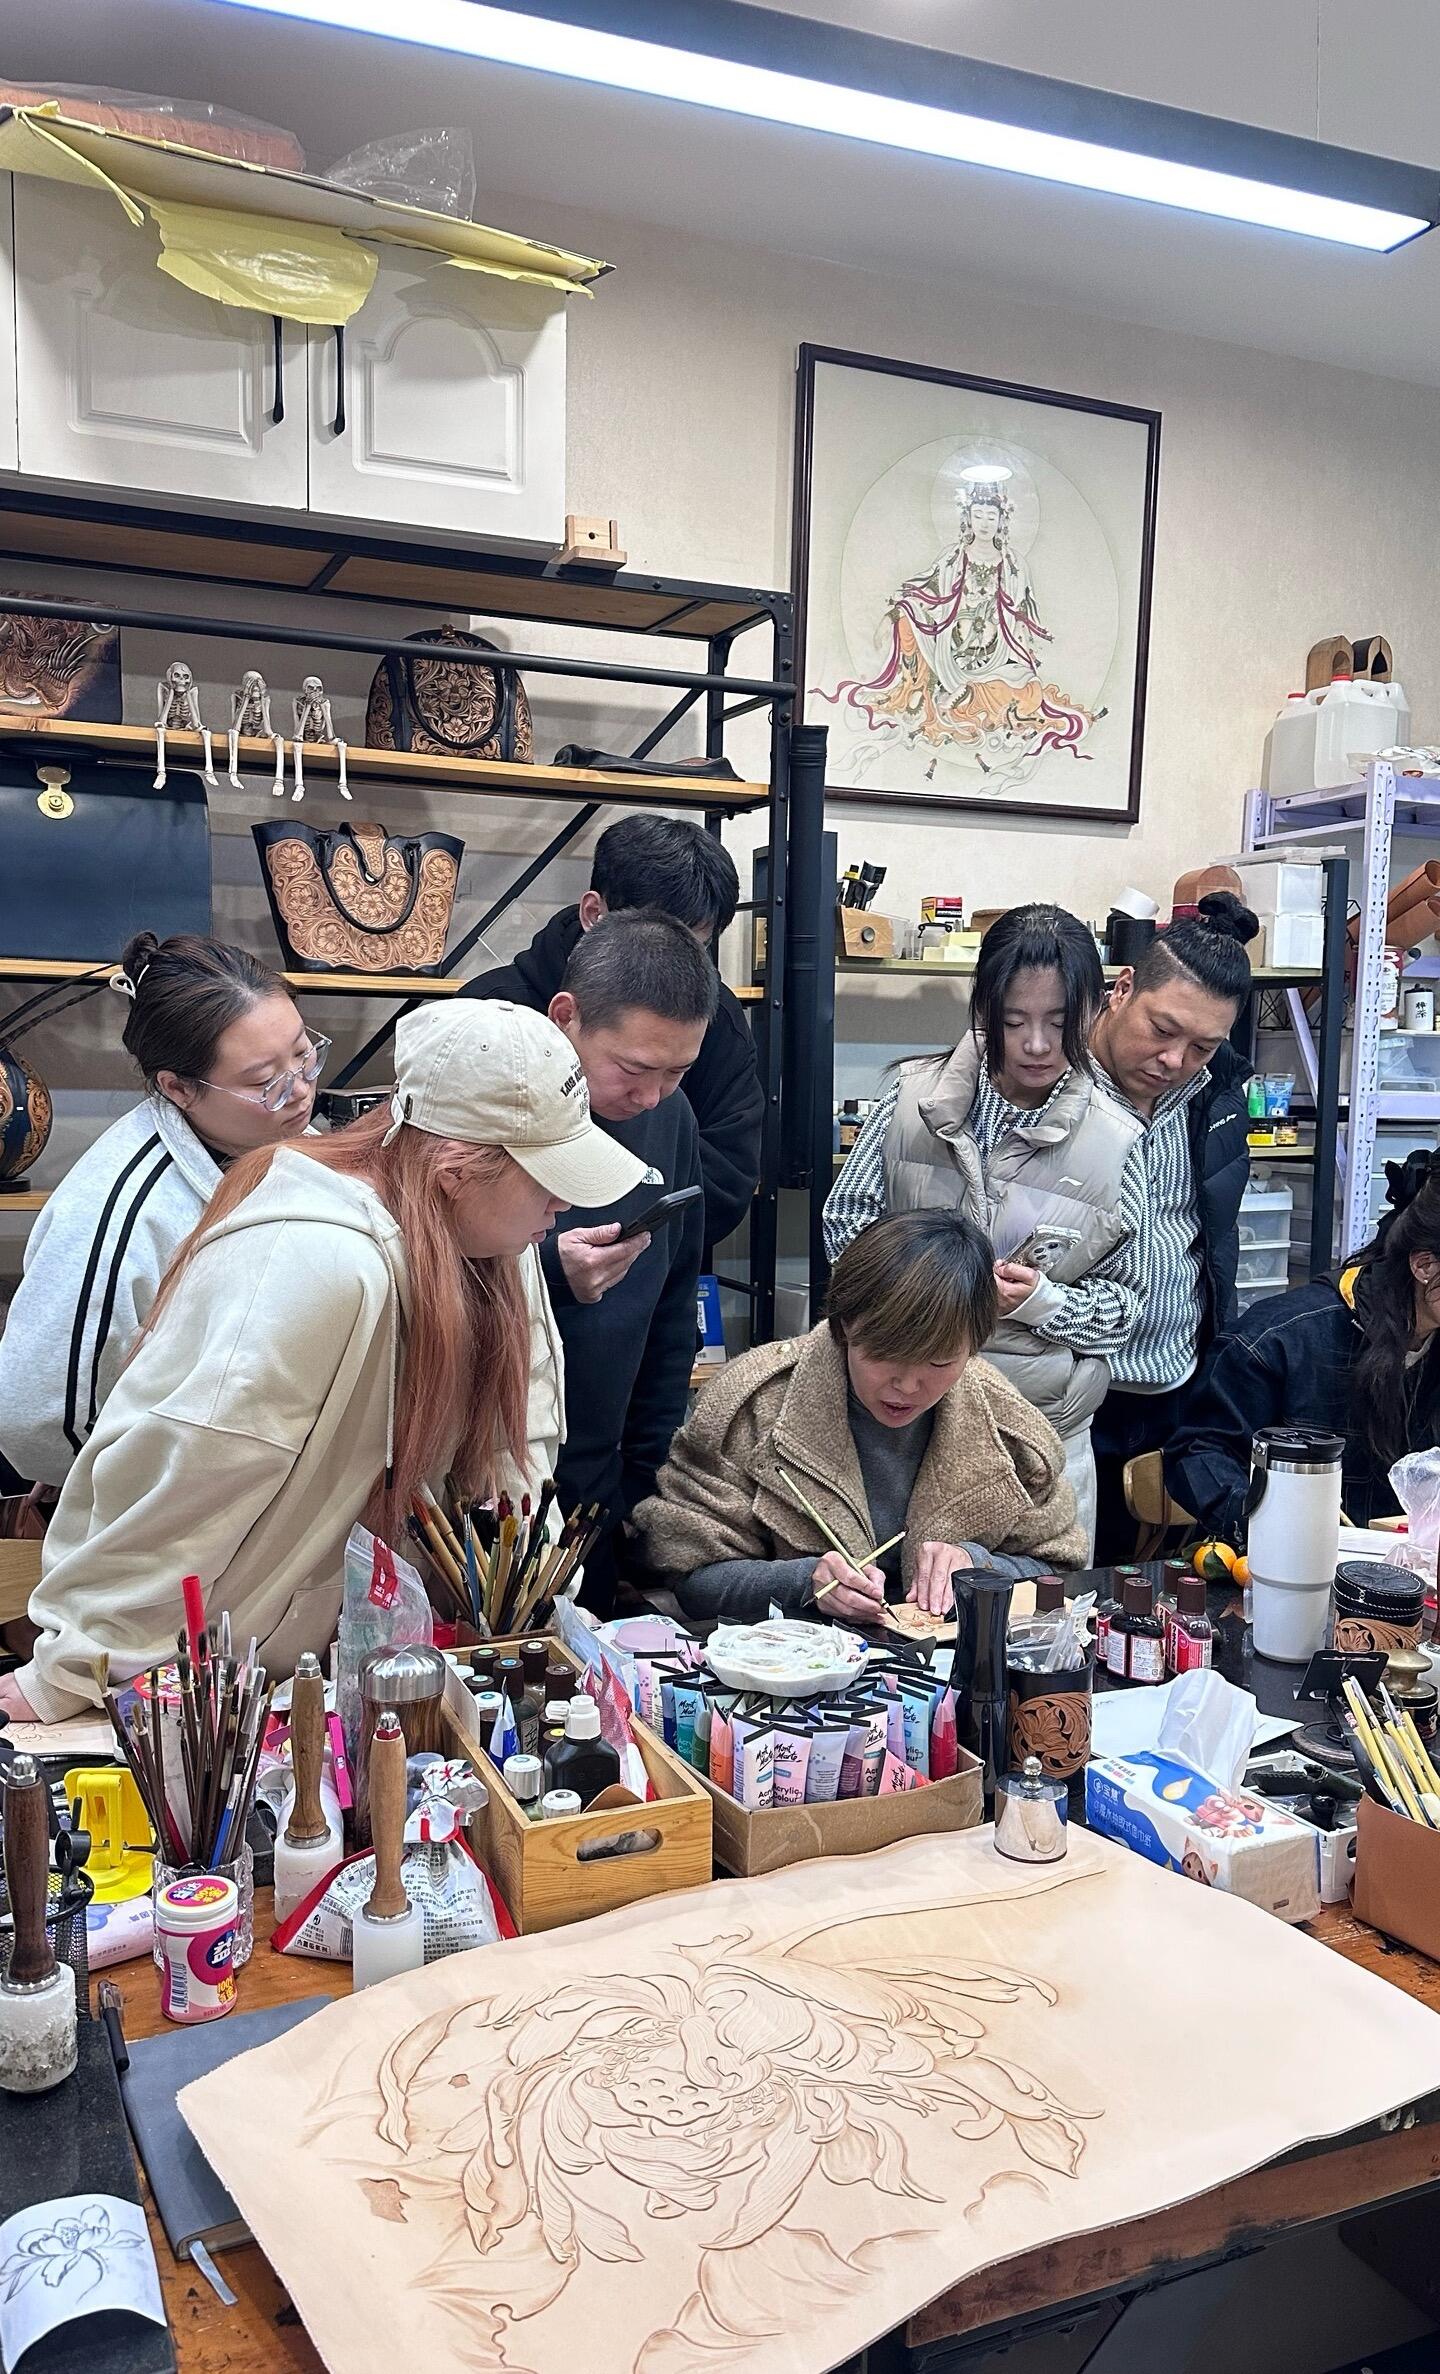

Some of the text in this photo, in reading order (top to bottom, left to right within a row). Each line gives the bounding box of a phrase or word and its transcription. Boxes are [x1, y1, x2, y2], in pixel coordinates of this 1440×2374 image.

[774, 1742, 794, 1754] Mont
[775, 1750, 798, 1761] Marte
[772, 1782, 800, 1795] Acrylic
[773, 1791, 799, 1803] Colour
